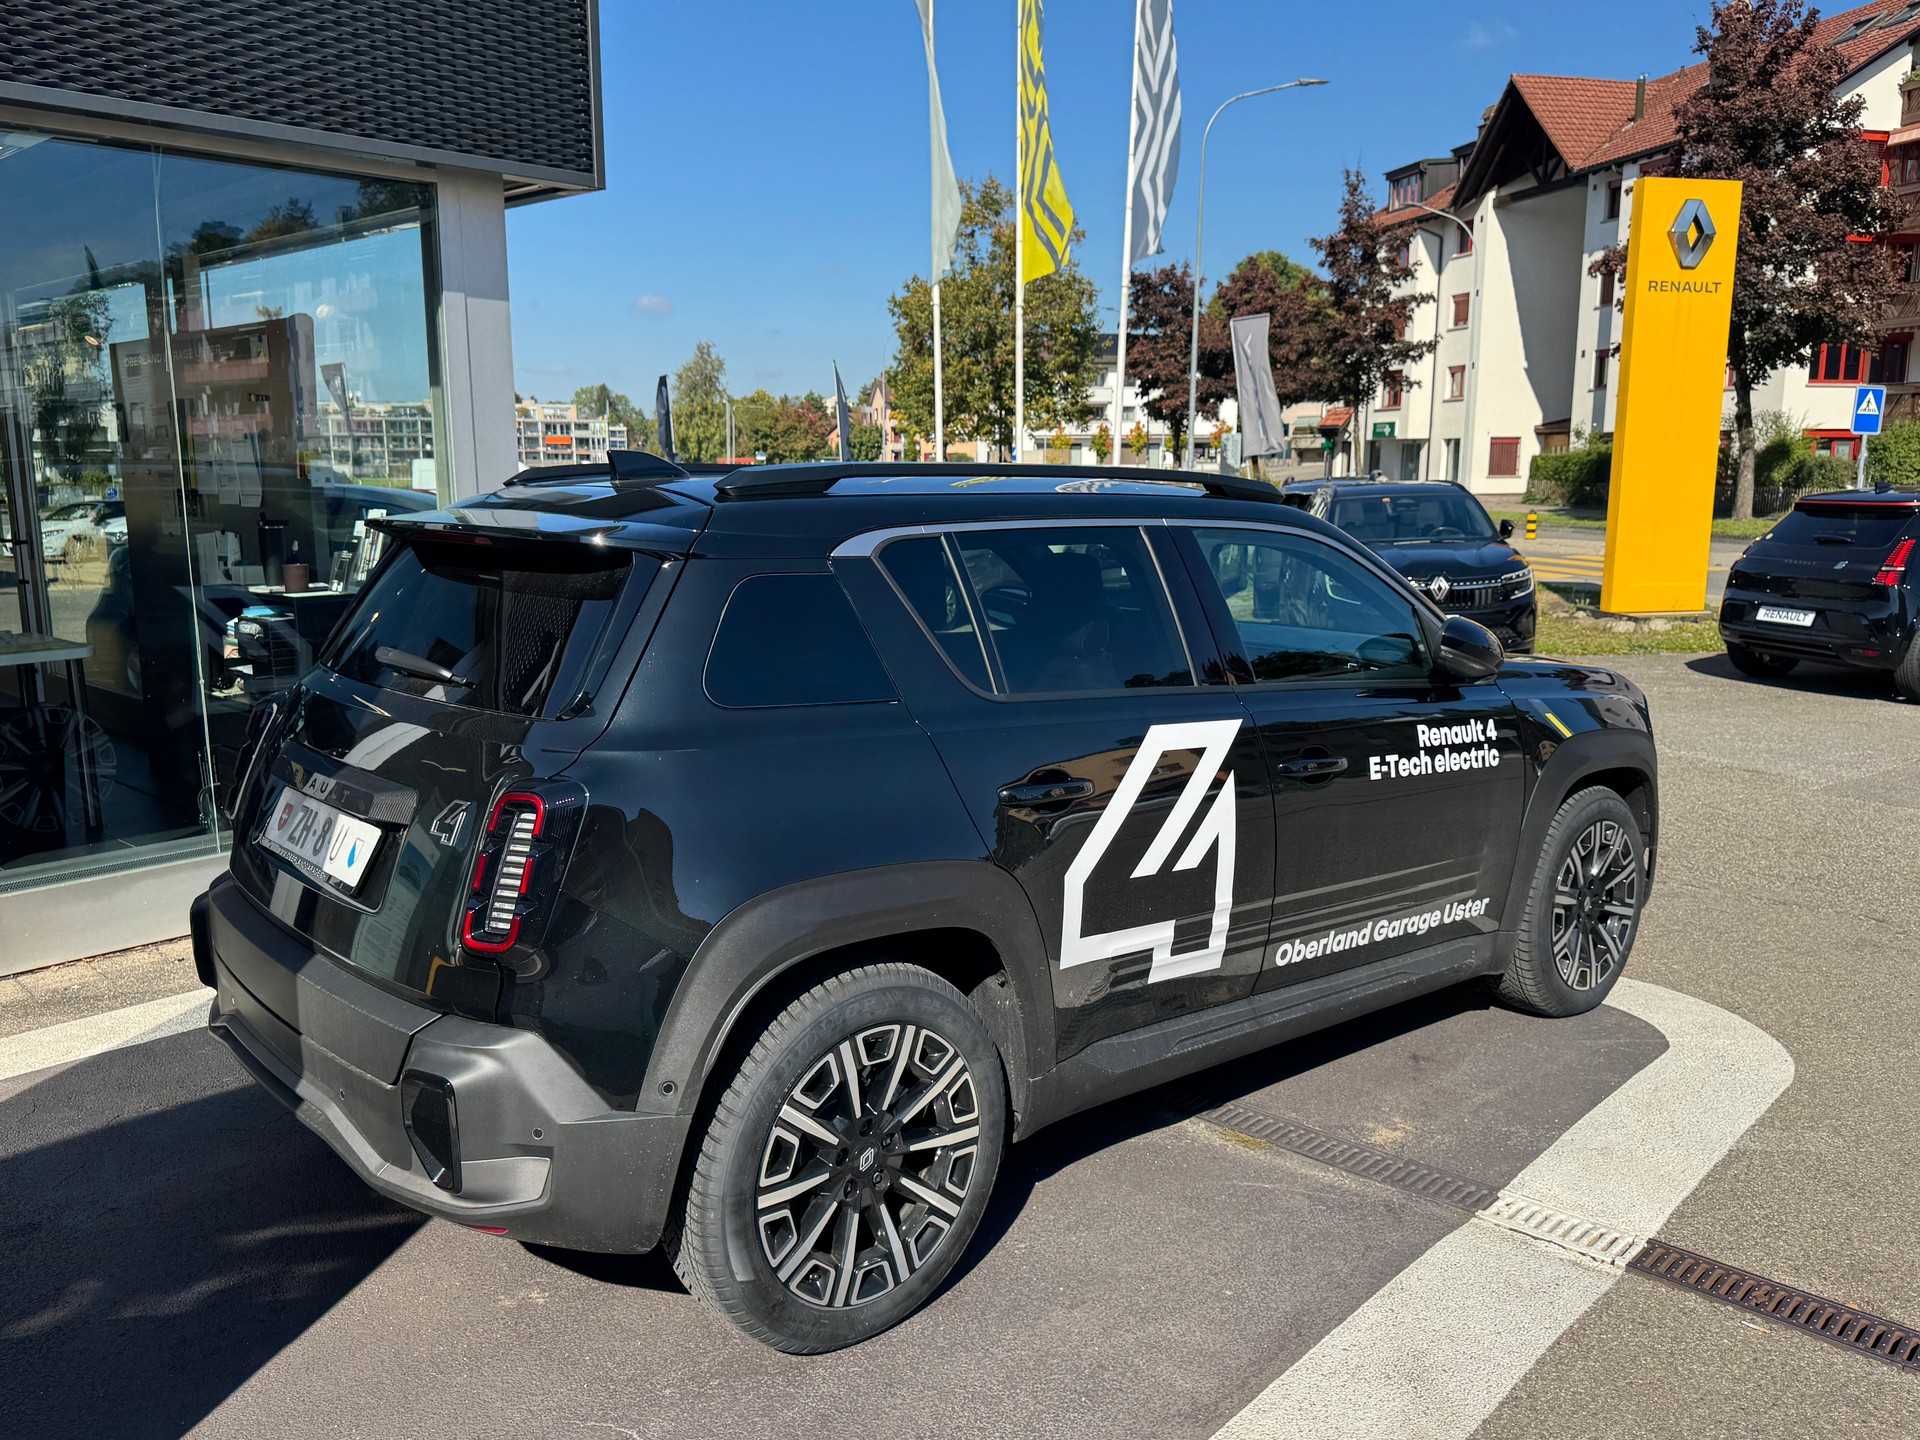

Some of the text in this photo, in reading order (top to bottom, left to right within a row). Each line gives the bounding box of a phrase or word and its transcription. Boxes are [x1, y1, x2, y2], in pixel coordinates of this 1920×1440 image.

[1648, 280, 1722, 294] RENAULT
[124, 352, 162, 368] OBERLAND
[1763, 609, 1809, 623] RENAULT
[1416, 718, 1498, 748] Renault 4
[1368, 743, 1500, 781] E-Tech electric
[1060, 718, 1244, 985] 4
[1275, 897, 1490, 967] Oberland Garage Uster
